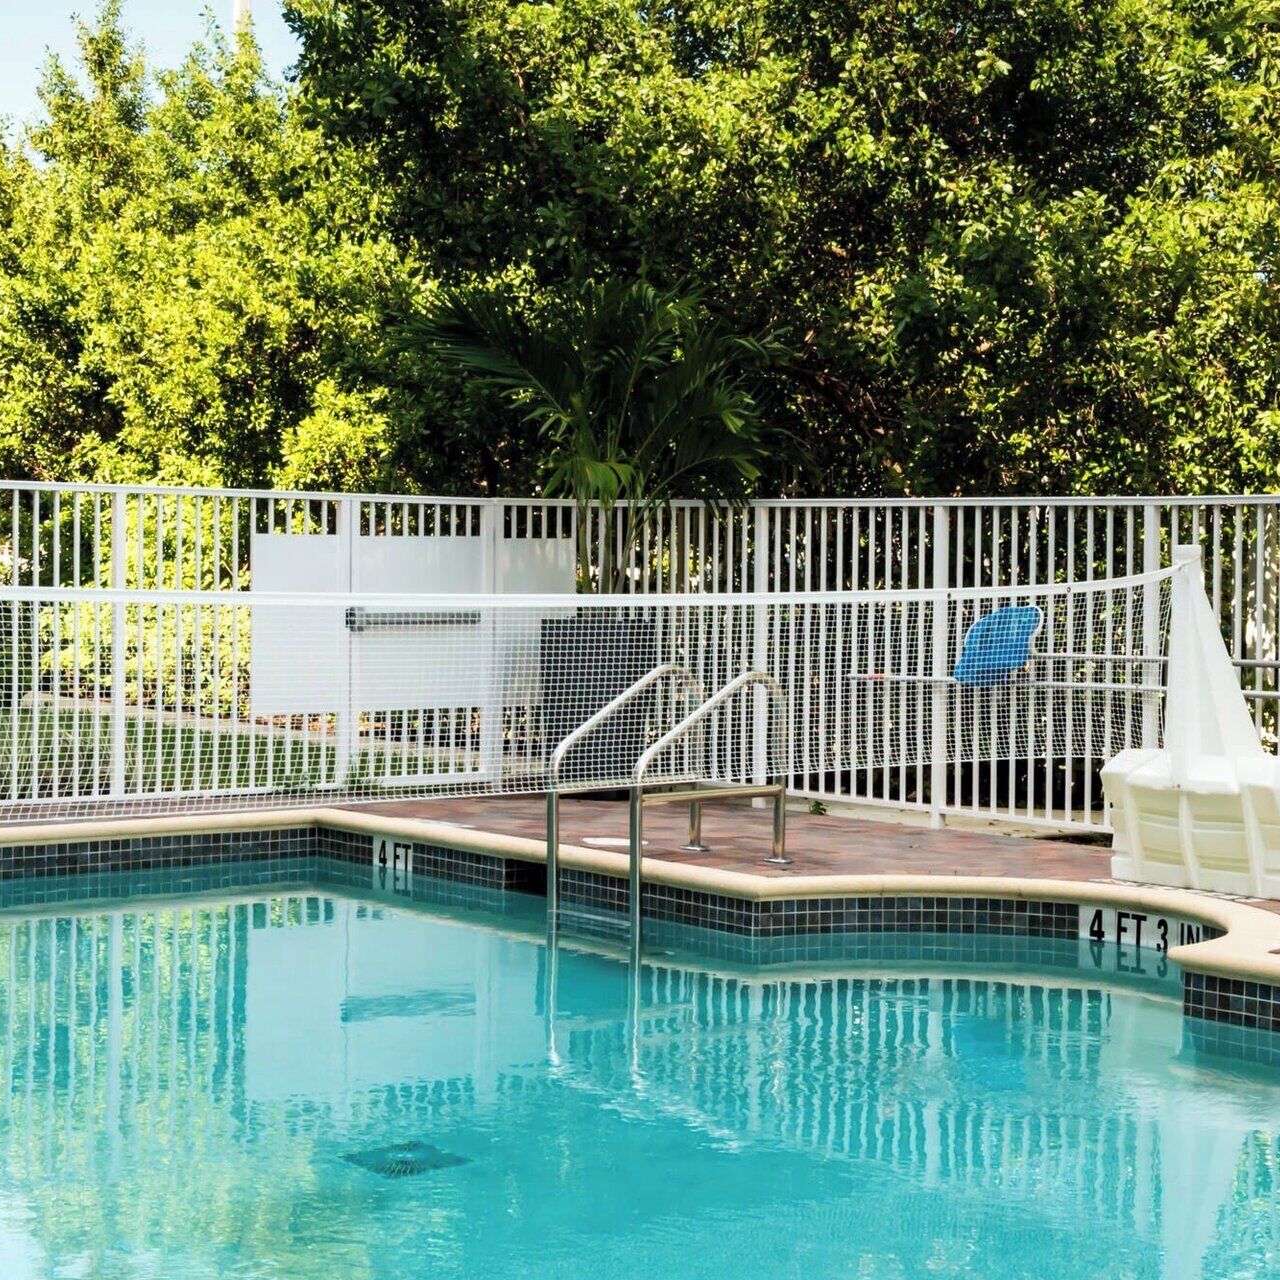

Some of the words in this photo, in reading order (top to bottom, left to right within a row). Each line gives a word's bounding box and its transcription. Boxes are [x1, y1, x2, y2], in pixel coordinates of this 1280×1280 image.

[379, 840, 387, 868] 4
[394, 842, 412, 871] FT
[1089, 909, 1105, 941] 4
[1116, 911, 1147, 945] FT
[1156, 918, 1168, 953] 3
[1180, 922, 1200, 946] IN
